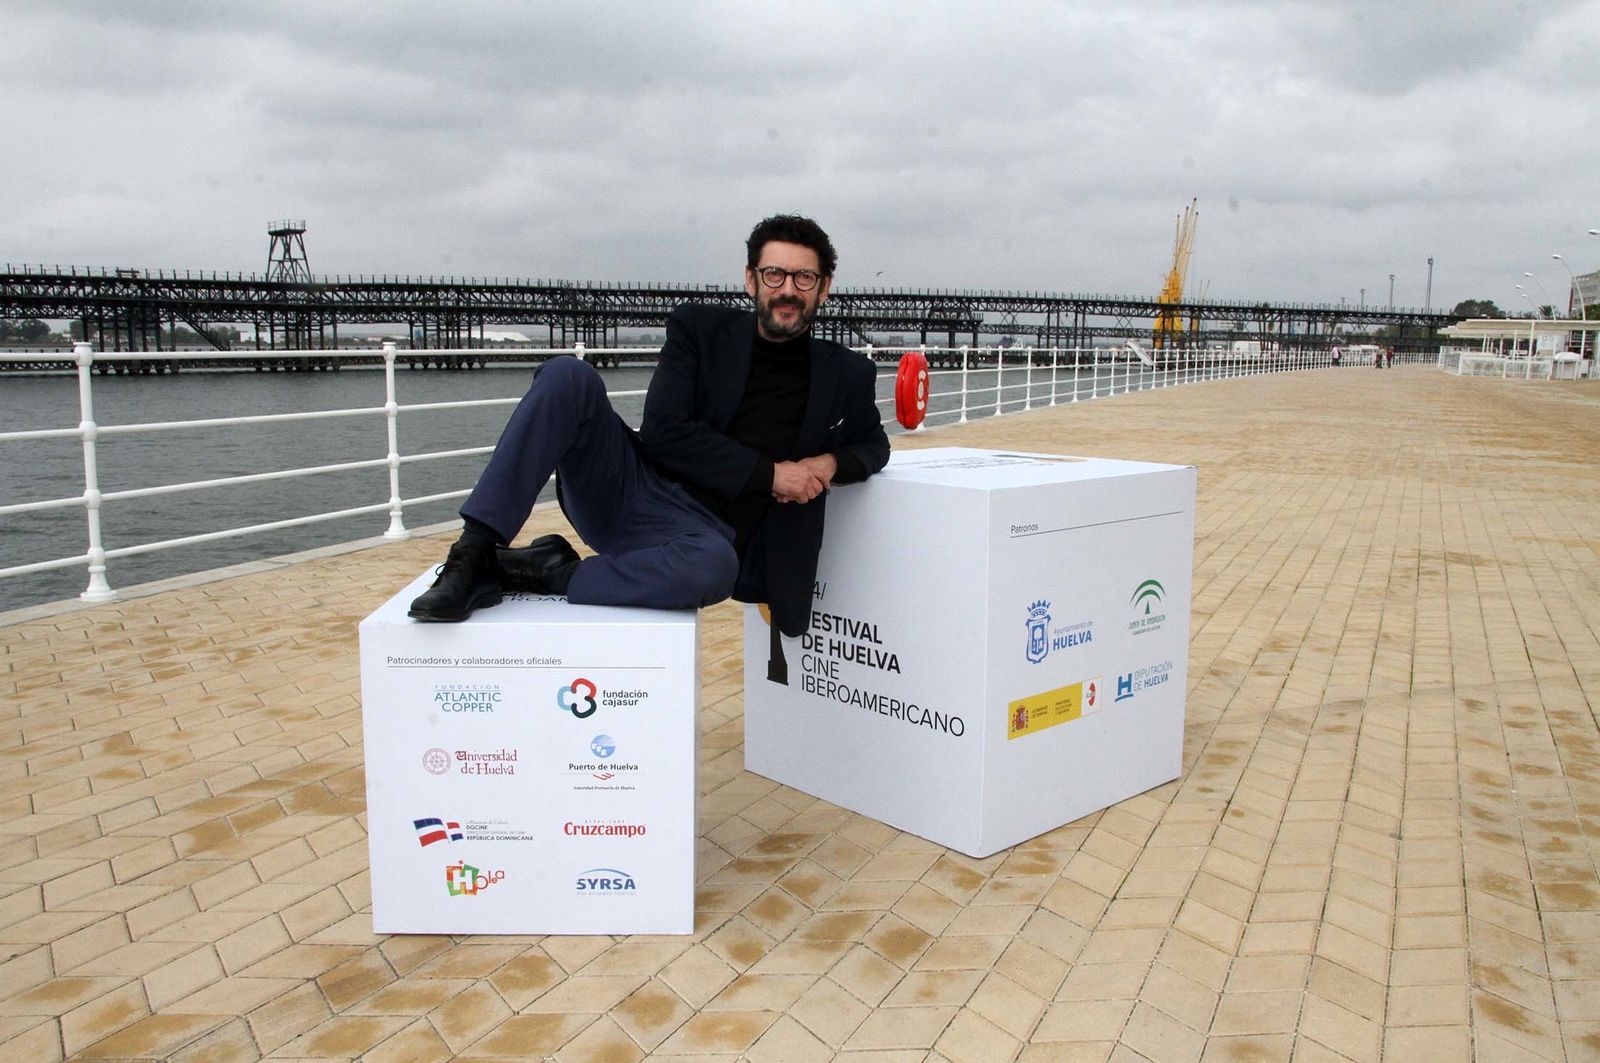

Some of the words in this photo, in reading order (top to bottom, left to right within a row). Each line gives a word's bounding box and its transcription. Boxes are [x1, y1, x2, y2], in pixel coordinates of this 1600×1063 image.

[1010, 523, 1039, 534] Patronos
[811, 610, 883, 645] ESTIVAL
[1053, 630, 1093, 651] HUELVA
[802, 633, 824, 654] DE
[829, 638, 902, 674] HUELVA
[387, 656, 451, 665] Patrocinadores
[455, 658, 459, 666] y
[461, 656, 524, 665] colaboradores
[526, 656, 562, 666] oficiales
[801, 654, 840, 680] CINE
[1143, 673, 1169, 688] HUELVA
[434, 692, 502, 702] ATLANTIC
[602, 690, 648, 698] fundación
[441, 702, 494, 712] COPPER
[602, 698, 639, 707] cajasur
[801, 673, 965, 737] IBEROAMERICANO
[455, 749, 517, 761] Universidad
[460, 762, 475, 774] de
[476, 762, 515, 775] Huelva
[568, 763, 596, 771] Puerto
[597, 763, 608, 771] de
[610, 763, 639, 771] Huelva
[564, 821, 647, 837] Cruzcampo
[576, 878, 636, 890] SYRSA
